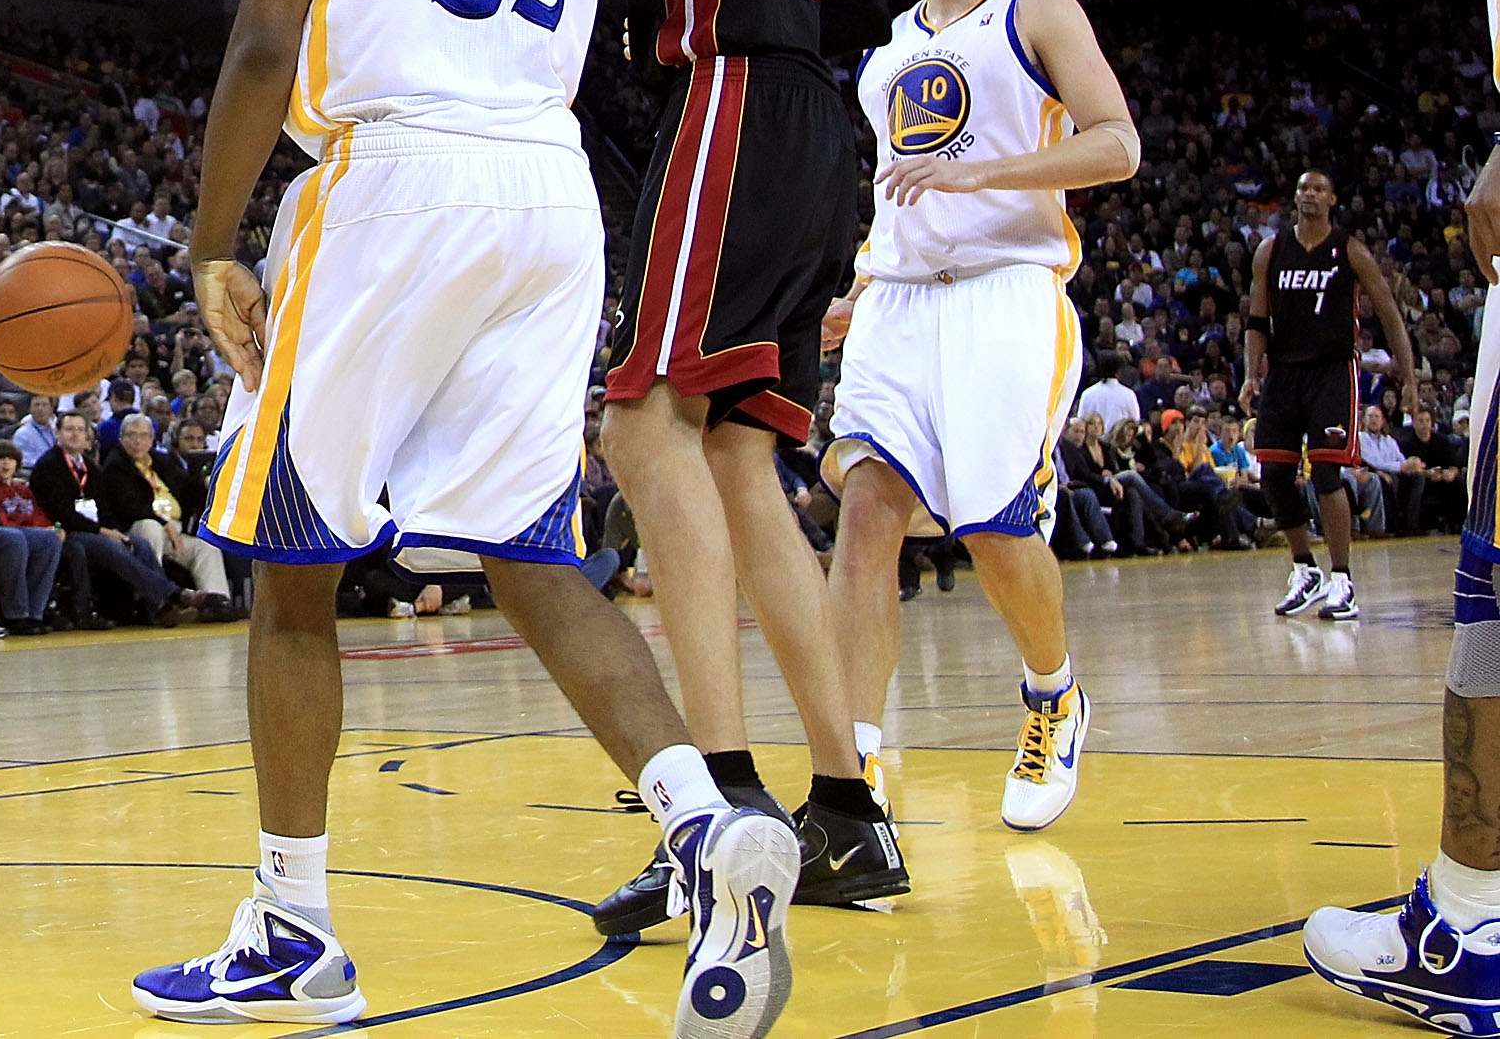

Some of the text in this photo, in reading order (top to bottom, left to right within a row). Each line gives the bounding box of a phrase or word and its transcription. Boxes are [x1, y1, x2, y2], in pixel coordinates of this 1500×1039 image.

[881, 48, 971, 93] GOLDEN STATE
[921, 75, 948, 103] 10
[1278, 265, 1339, 290] HEAT
[1314, 292, 1325, 315] 1
